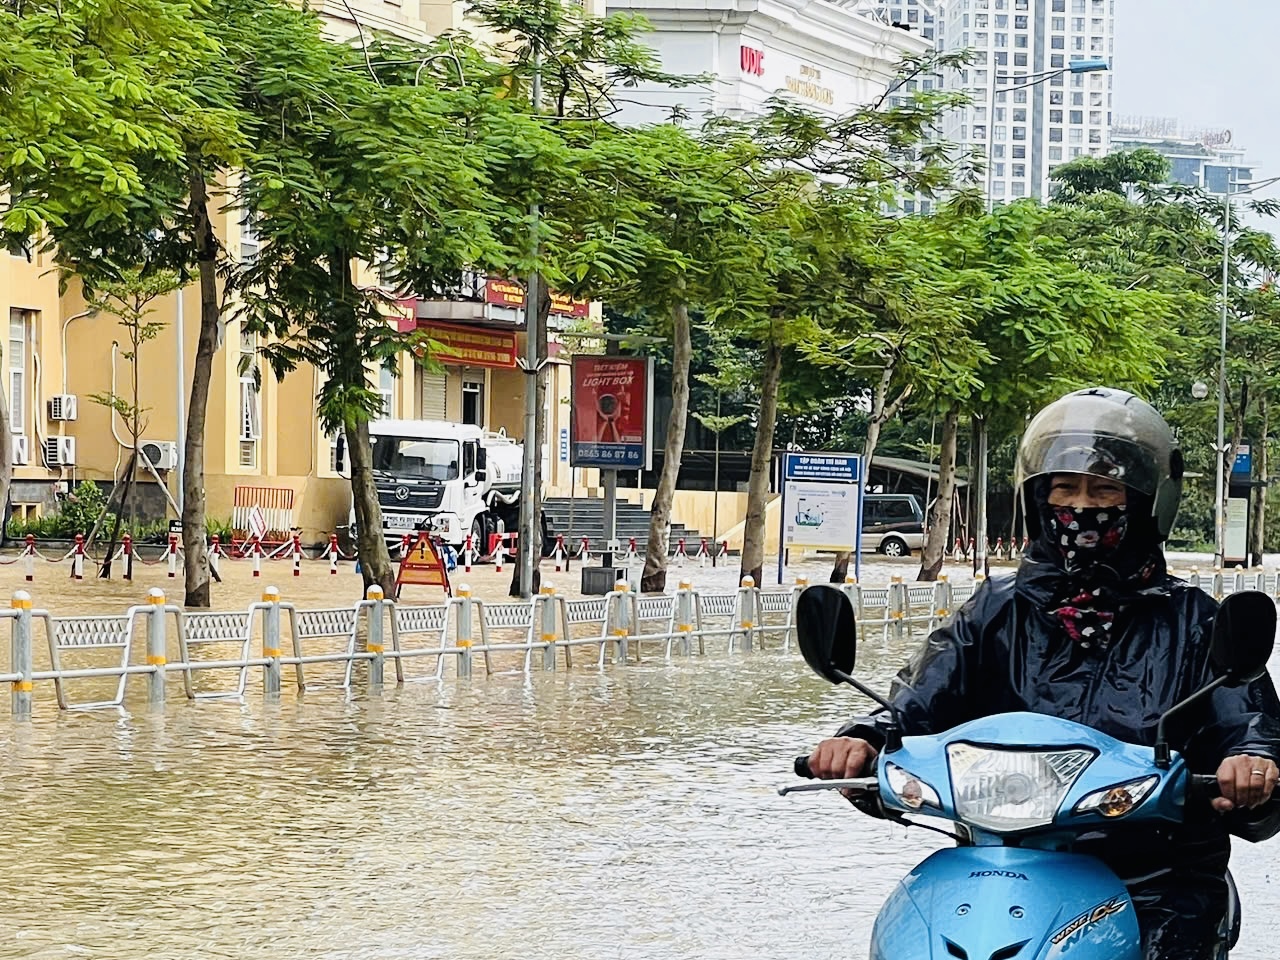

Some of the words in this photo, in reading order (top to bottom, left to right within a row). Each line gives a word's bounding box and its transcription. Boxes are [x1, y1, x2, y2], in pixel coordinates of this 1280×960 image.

[740, 45, 764, 77] UDIC
[582, 378, 612, 387] LIGHT
[612, 376, 634, 385] BOX
[968, 870, 1029, 881] HONDA
[1050, 914, 1089, 944] WAVE
